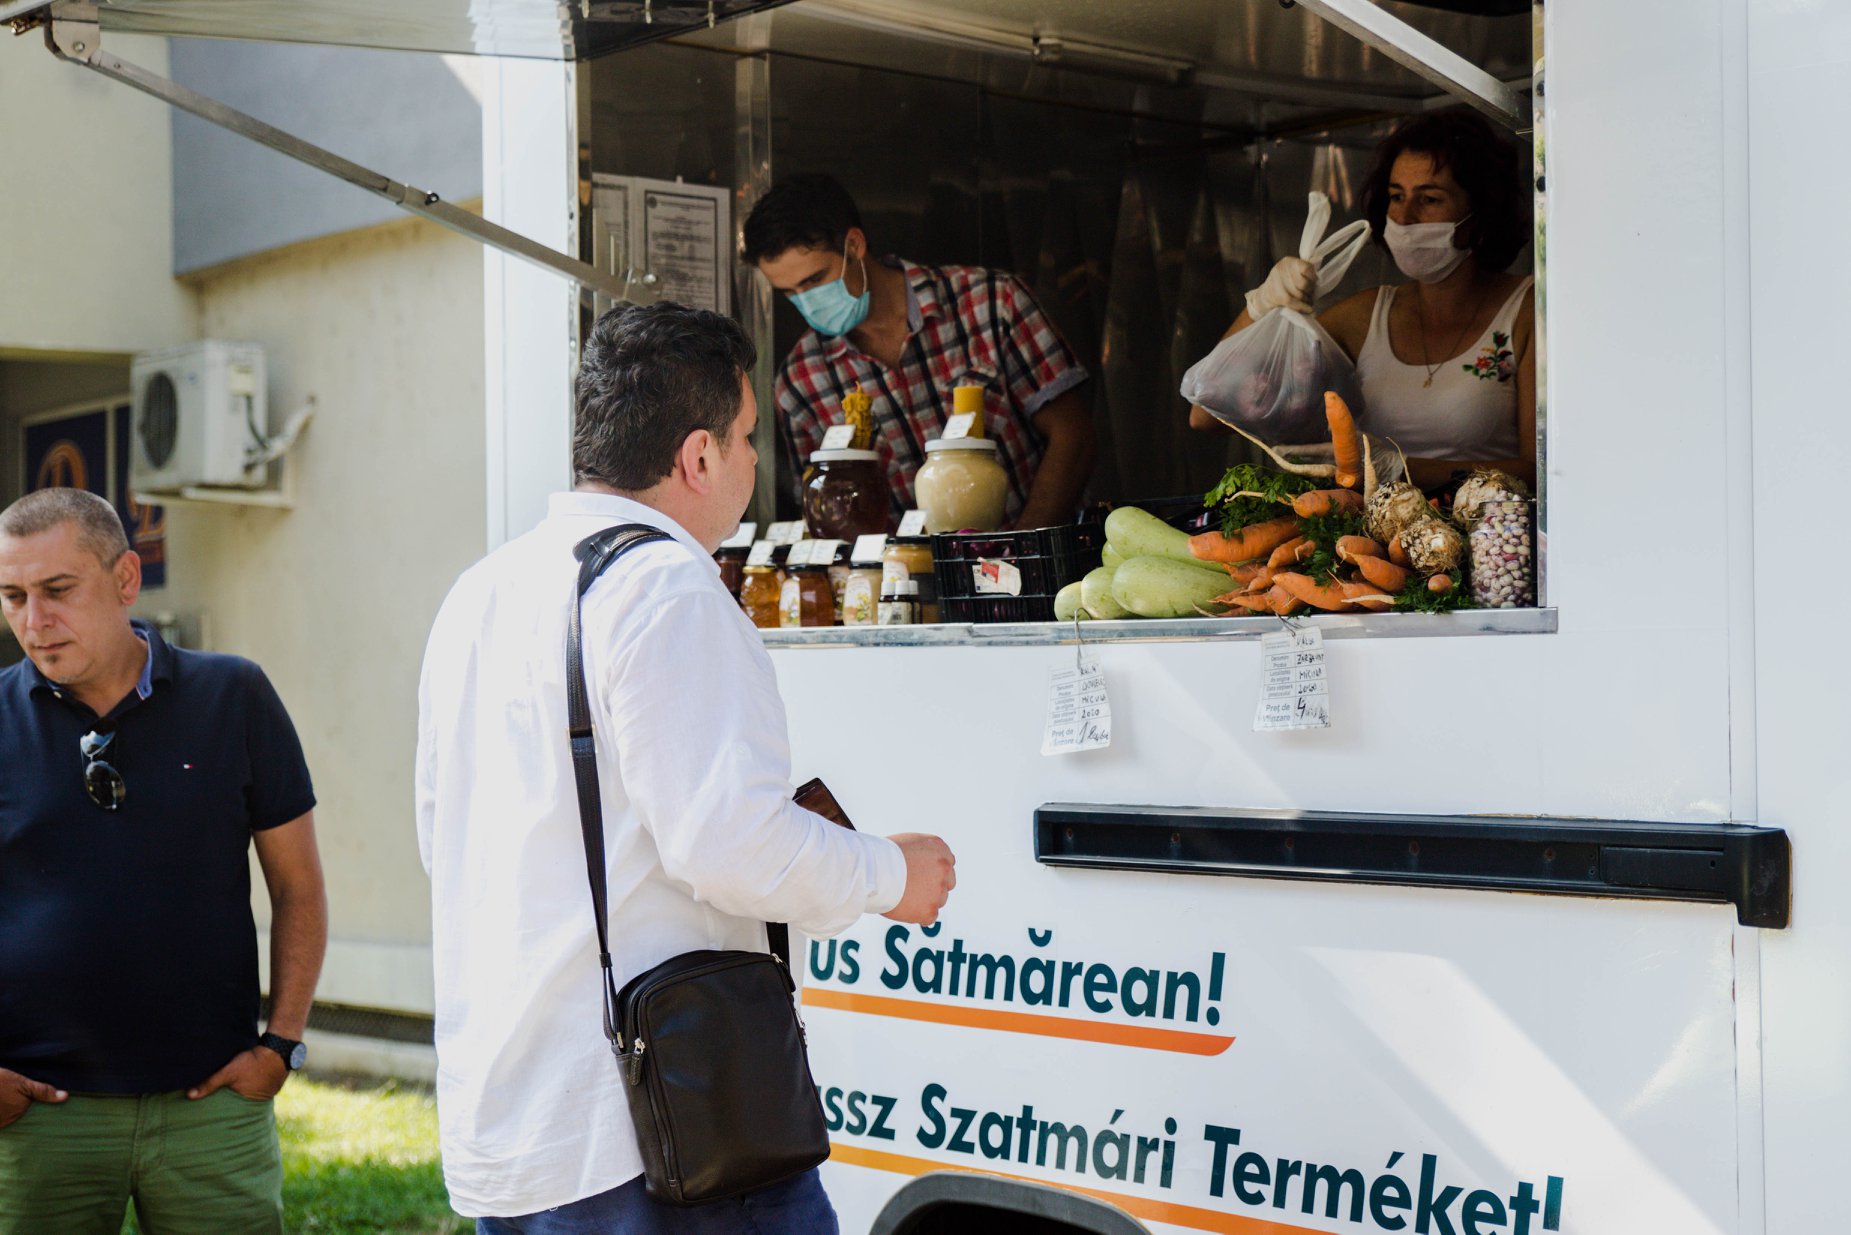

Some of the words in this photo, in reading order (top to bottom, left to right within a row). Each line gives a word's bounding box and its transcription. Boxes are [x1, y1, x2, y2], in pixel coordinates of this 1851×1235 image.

[880, 921, 1226, 1026] Sătmărean!
[816, 1085, 898, 1141] ssz
[916, 1083, 1178, 1189] Szatmári
[1204, 1124, 1564, 1235] Terméket!
